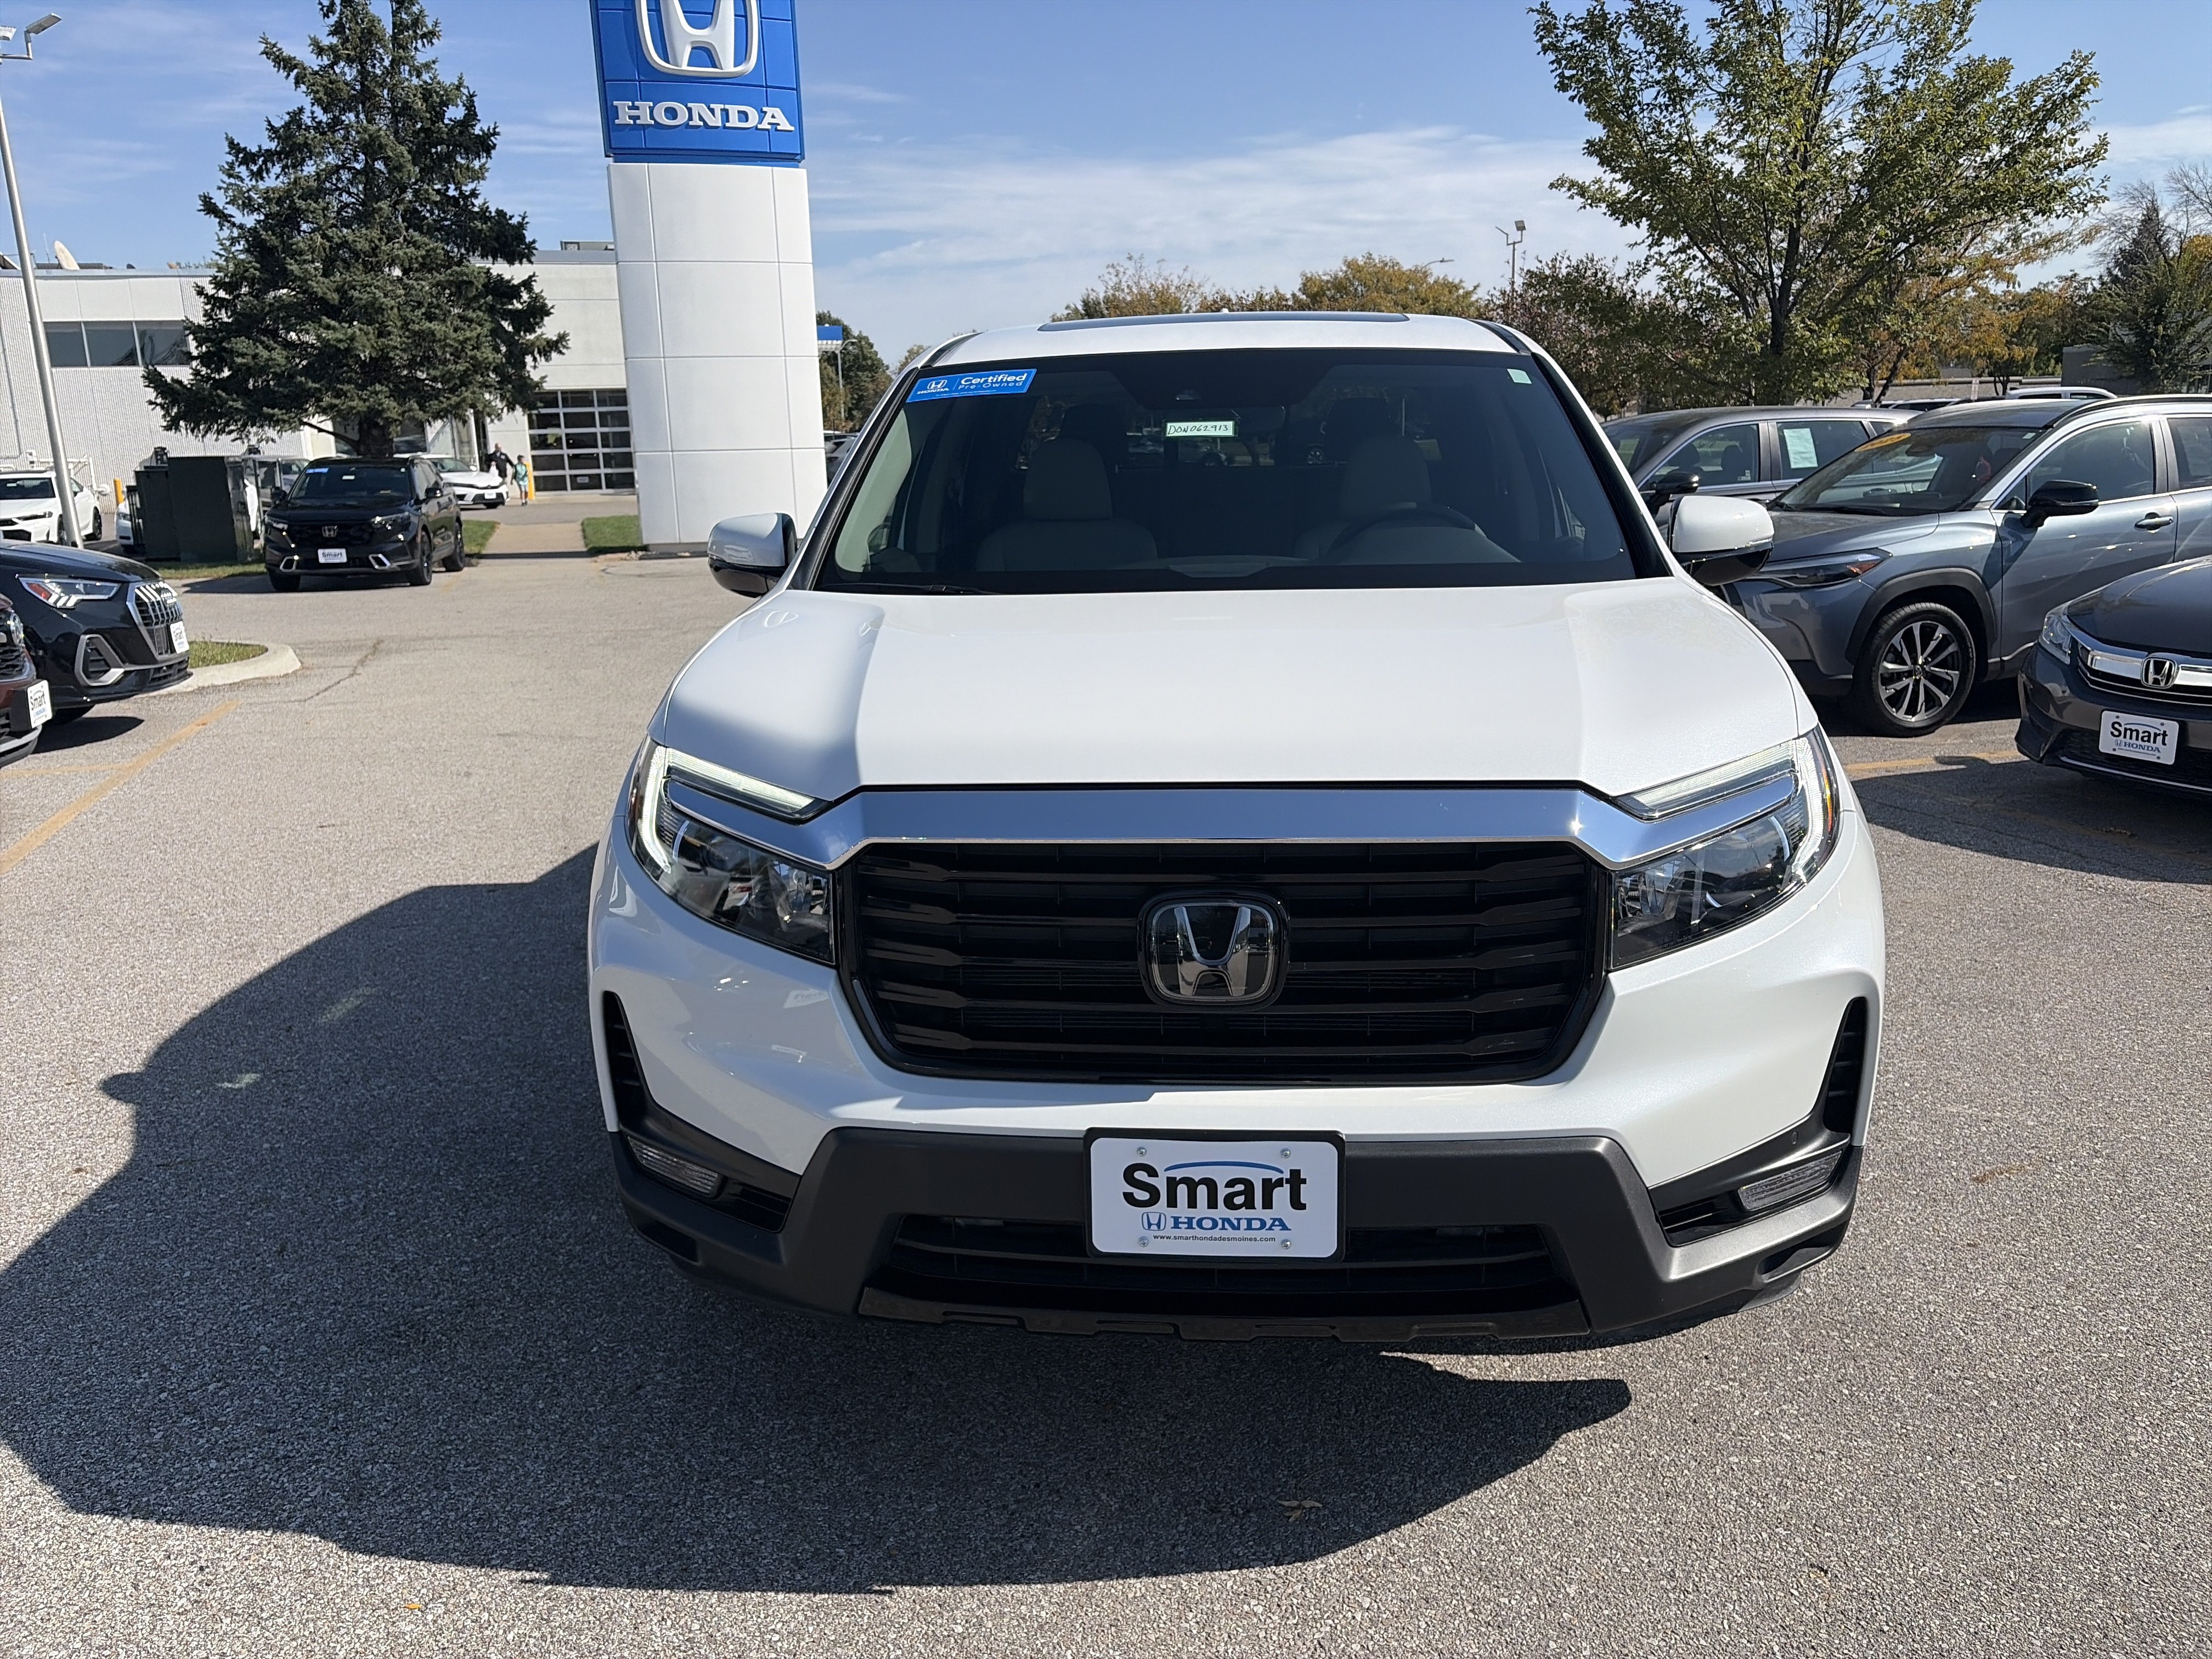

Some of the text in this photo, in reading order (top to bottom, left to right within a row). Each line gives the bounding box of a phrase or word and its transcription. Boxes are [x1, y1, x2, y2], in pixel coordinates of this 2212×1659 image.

[613, 101, 795, 131] HONDA
[961, 373, 1027, 385] Certified
[30, 691, 46, 711] Smart
[2110, 721, 2168, 746] Smart
[2124, 741, 2161, 753] HONDA
[1122, 1163, 1307, 1211] Smart
[1170, 1215, 1292, 1231] HONDA
[1153, 1234, 1276, 1243] www.smarthondadesmoines.com
